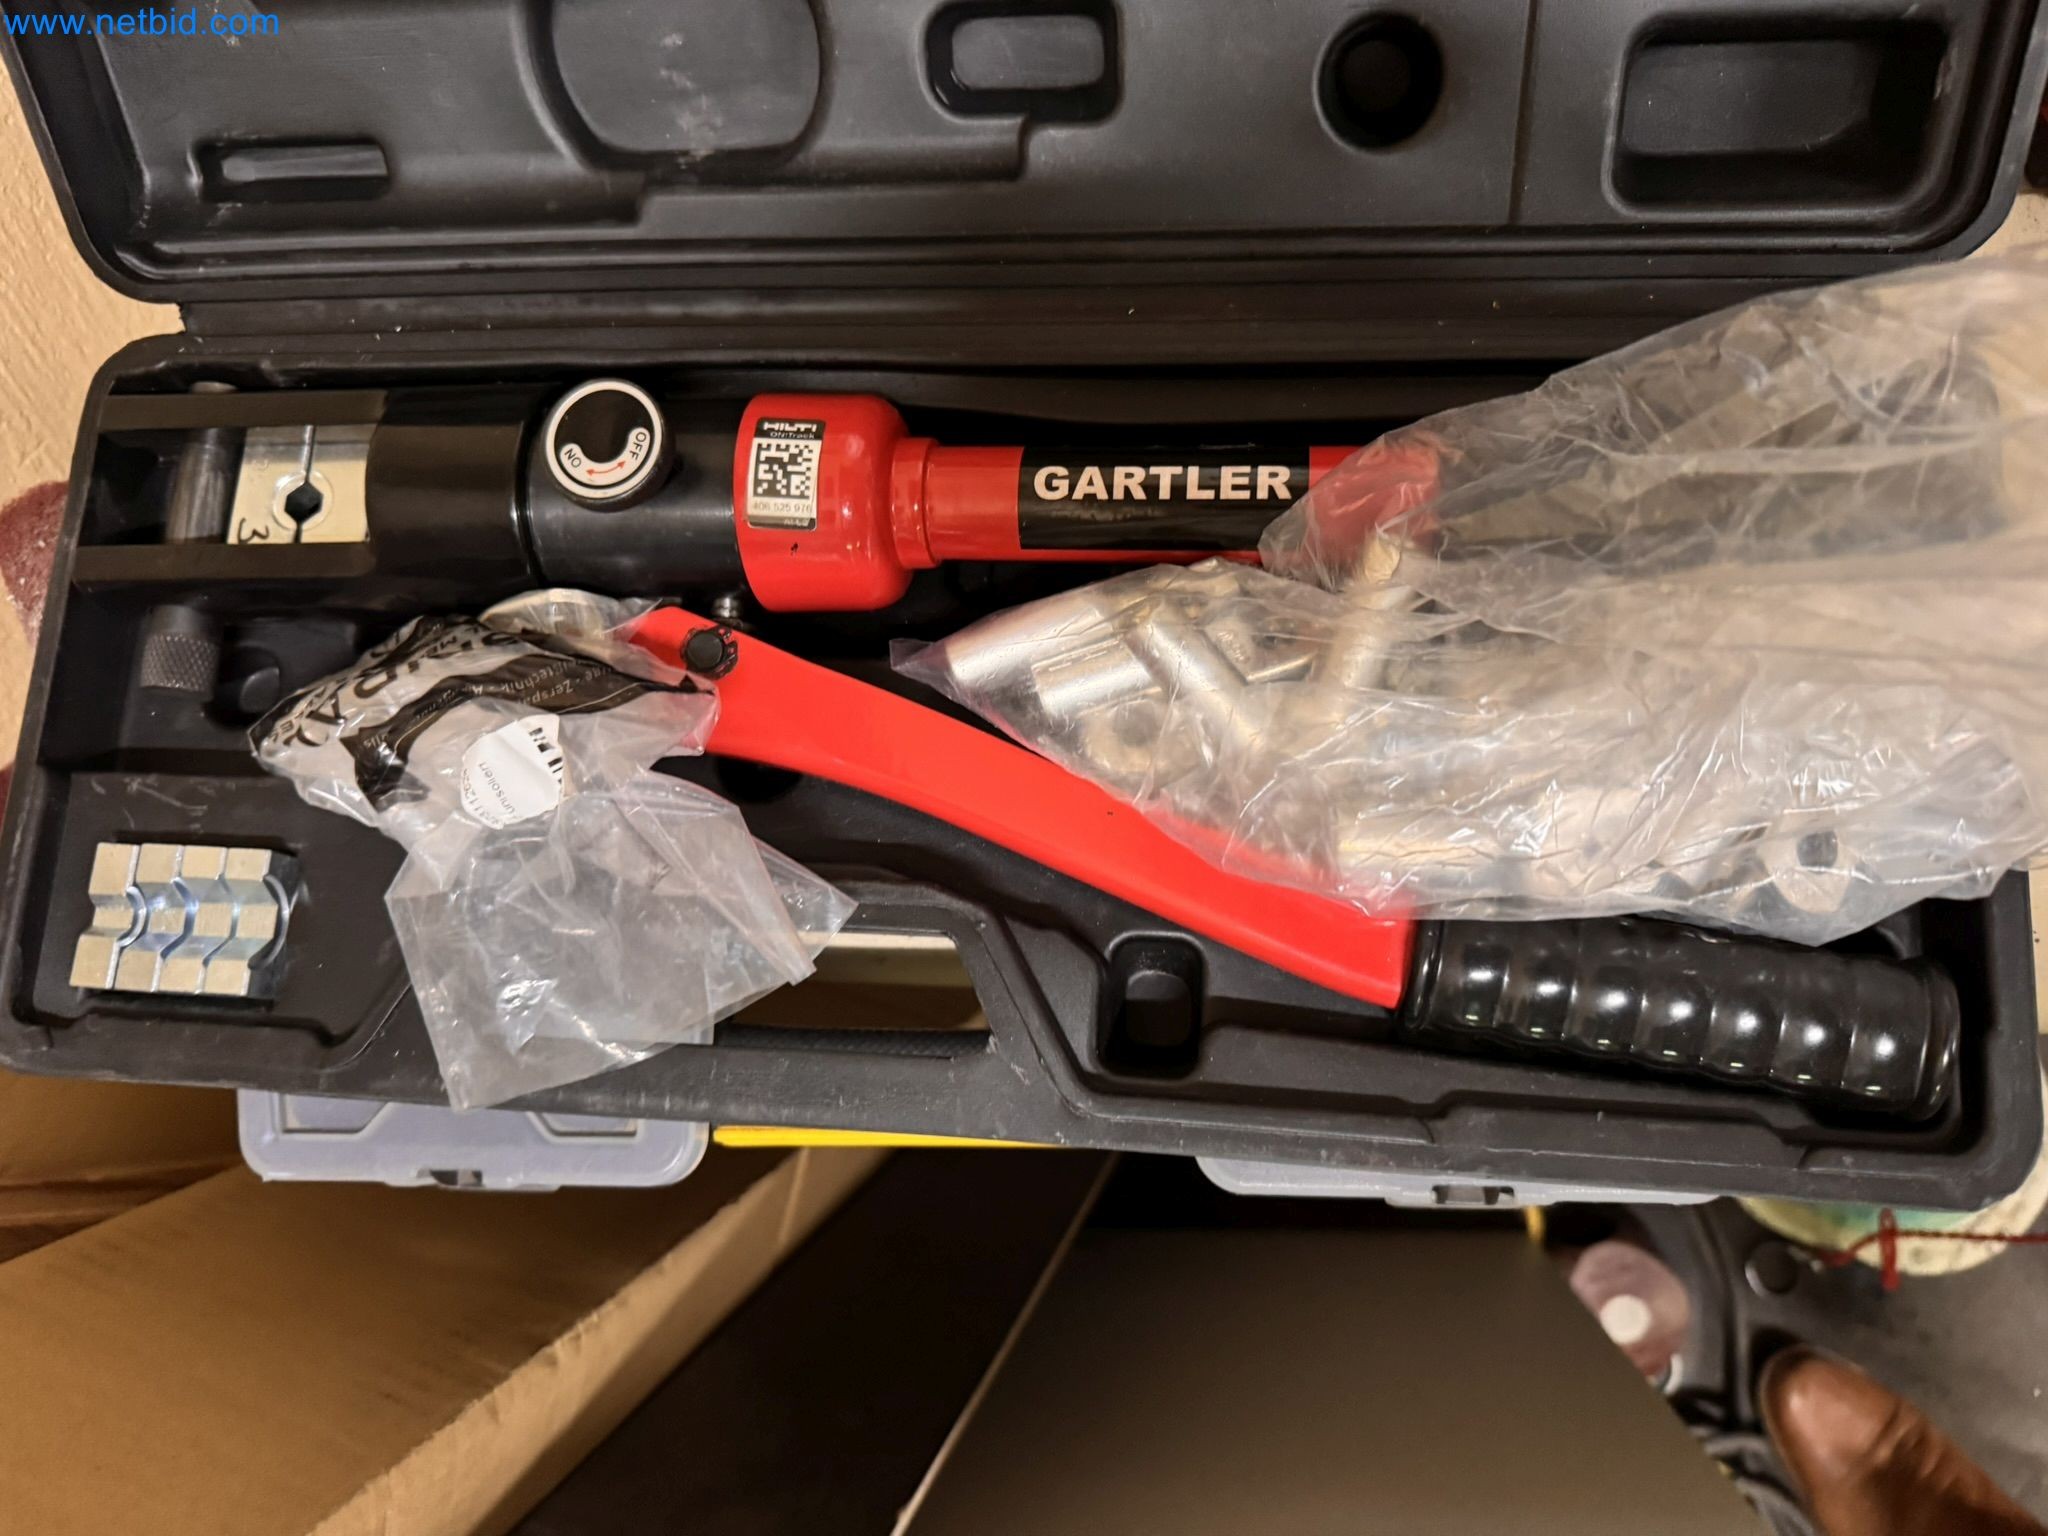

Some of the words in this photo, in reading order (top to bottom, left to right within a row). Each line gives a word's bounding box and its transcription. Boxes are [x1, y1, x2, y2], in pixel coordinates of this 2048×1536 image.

[763, 421, 818, 433] HILTI
[563, 448, 583, 469] ON
[628, 431, 648, 461] OFF
[1033, 465, 1292, 501] GARTLER
